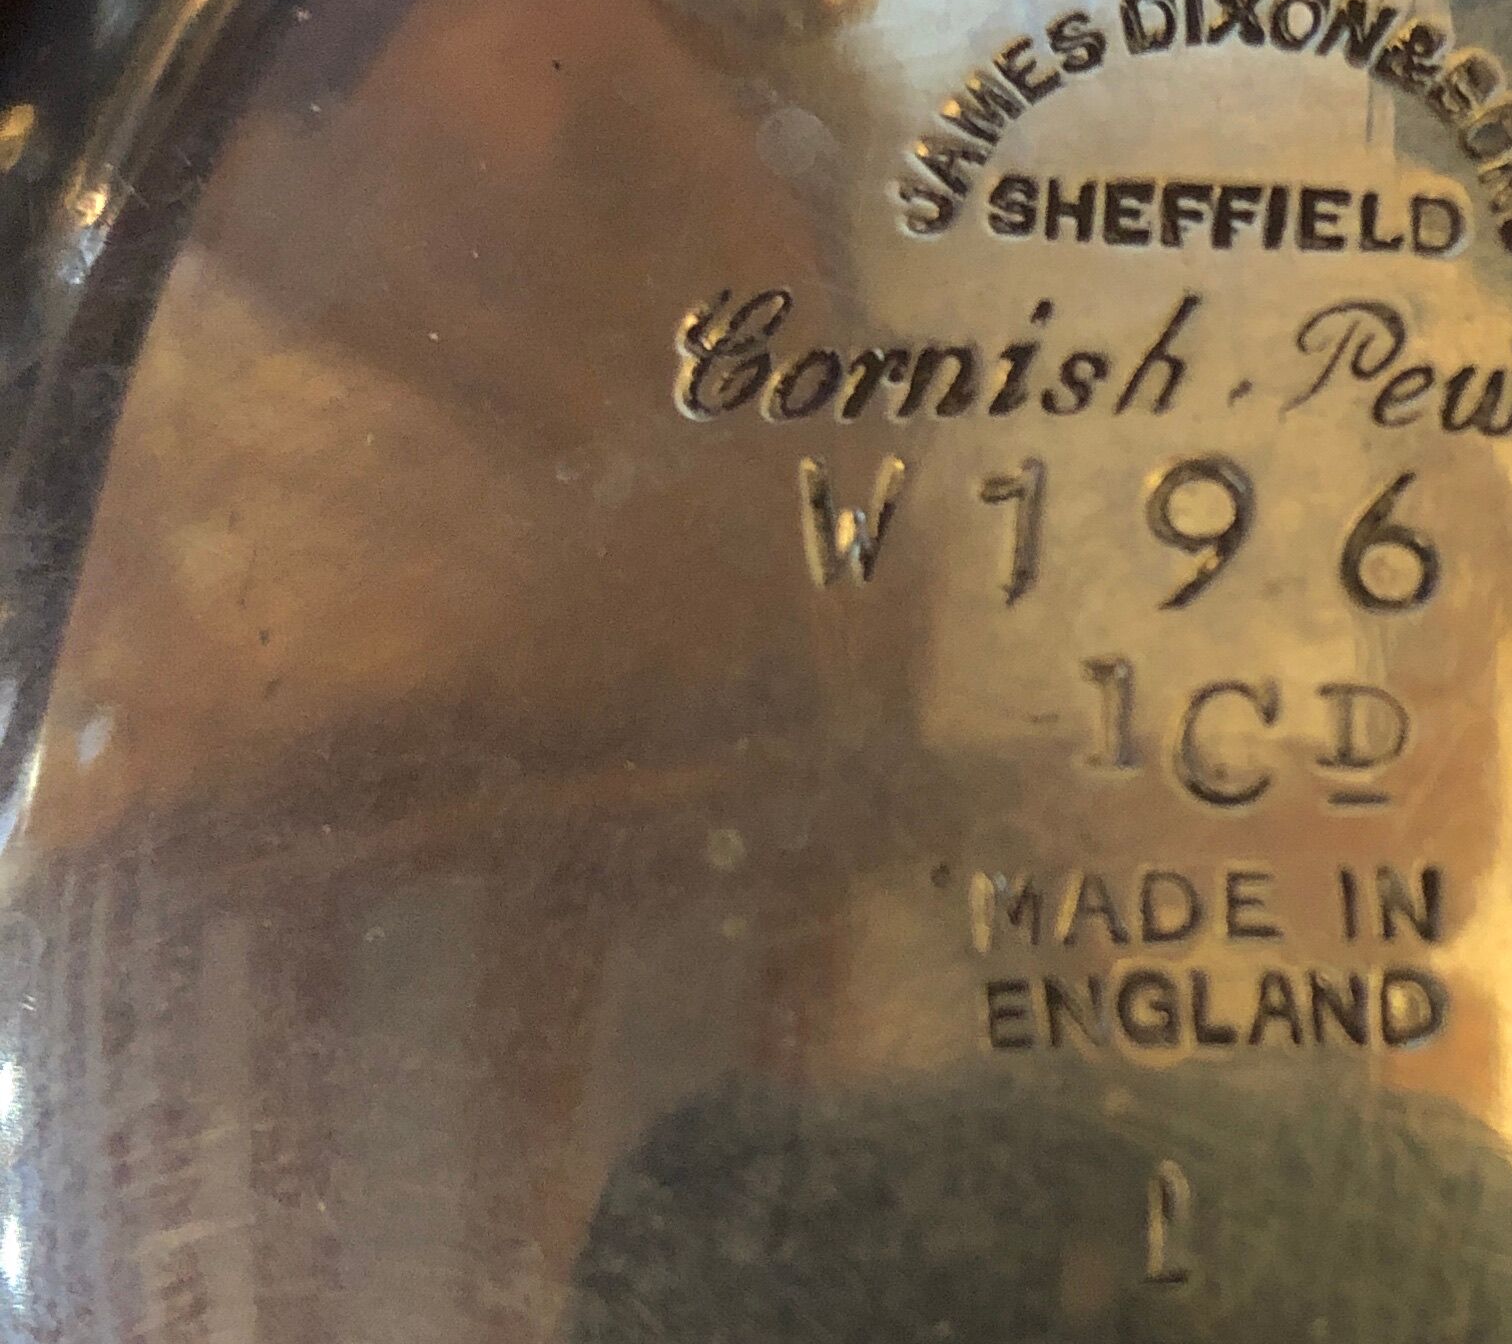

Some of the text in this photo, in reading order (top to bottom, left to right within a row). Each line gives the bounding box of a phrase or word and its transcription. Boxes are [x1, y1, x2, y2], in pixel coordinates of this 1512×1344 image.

[897, 10, 1108, 236] JAMES
[986, 173, 1468, 257] SHEFFIELD
[967, 864, 1442, 954] MADE IN
[985, 964, 1450, 1049] ENGLAND
